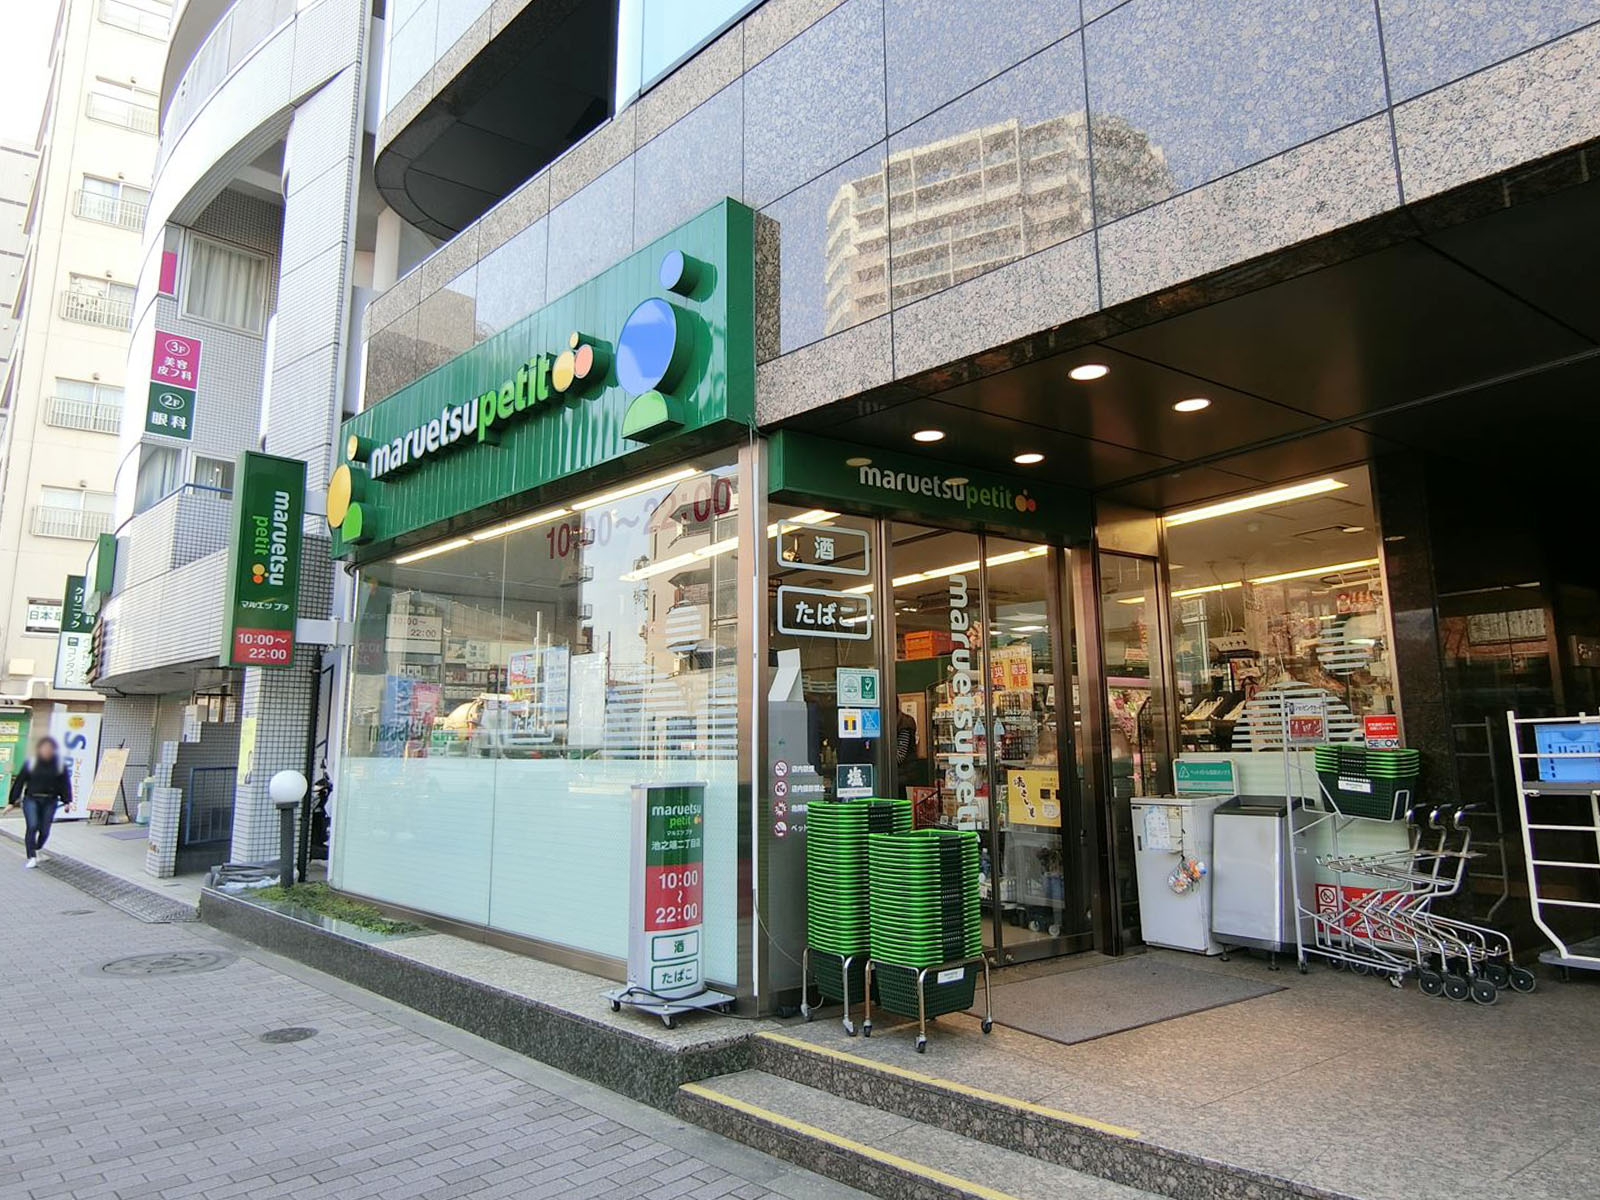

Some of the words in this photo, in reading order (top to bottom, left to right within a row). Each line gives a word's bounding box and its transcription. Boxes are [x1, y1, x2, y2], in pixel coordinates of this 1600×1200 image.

[170, 341, 187, 354] 3F
[164, 356, 188, 370] 美容
[157, 365, 192, 382] 皮フ科
[164, 395, 181, 407] 2F
[151, 411, 188, 430] 眼科
[252, 515, 271, 556] petit
[269, 490, 290, 586] maruetsu
[814, 536, 835, 560] 酒
[70, 586, 84, 629] クリニック
[795, 600, 858, 627] たばこ
[249, 647, 287, 660] 22:00
[652, 803, 701, 816] maruetsu
[669, 815, 691, 829] petit
[658, 871, 698, 889] 10:00
[655, 903, 698, 924] 22:00
[673, 940, 684, 954] 酒
[661, 968, 693, 984] たばこ
